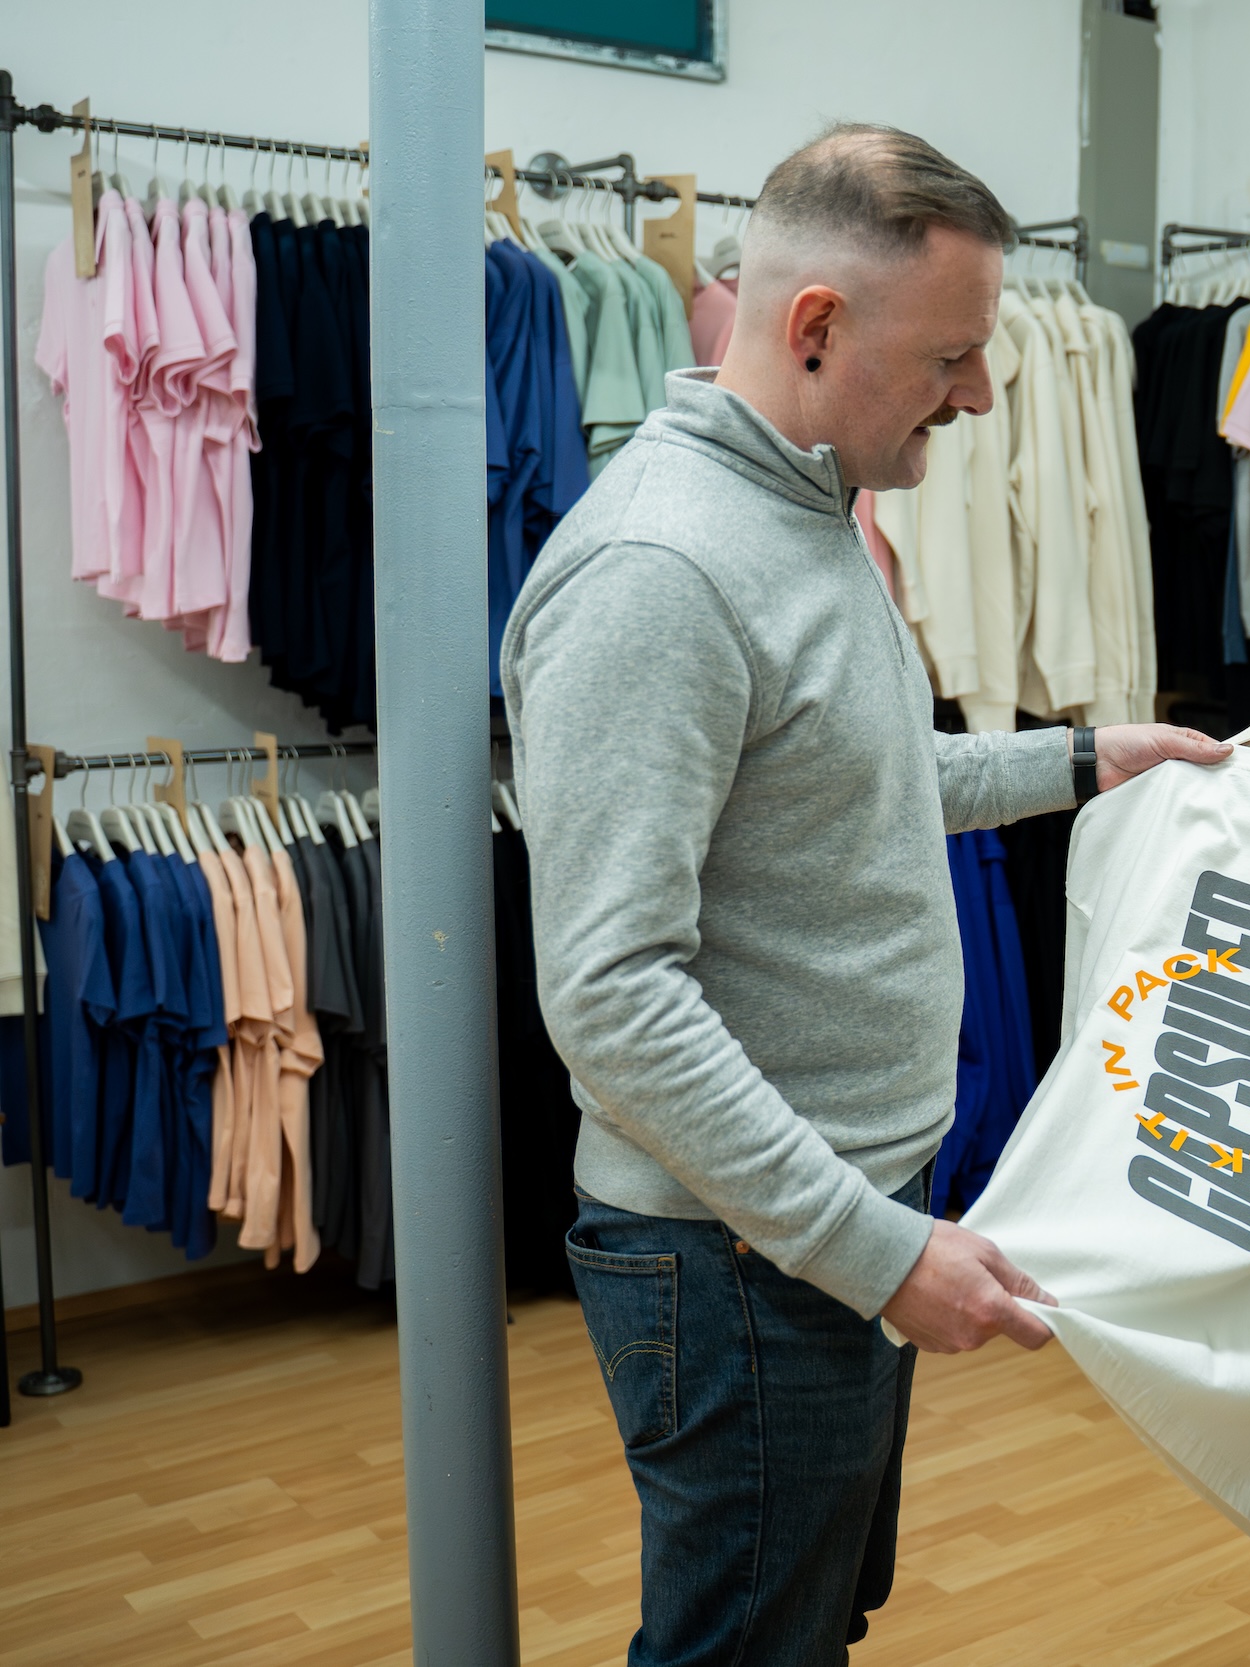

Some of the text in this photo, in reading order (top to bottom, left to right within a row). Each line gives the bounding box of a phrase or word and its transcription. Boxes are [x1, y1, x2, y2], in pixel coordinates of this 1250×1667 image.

[1108, 948, 1240, 1021] PACK
[1103, 1041, 1138, 1090] IN
[1136, 1113, 1188, 1150] IT
